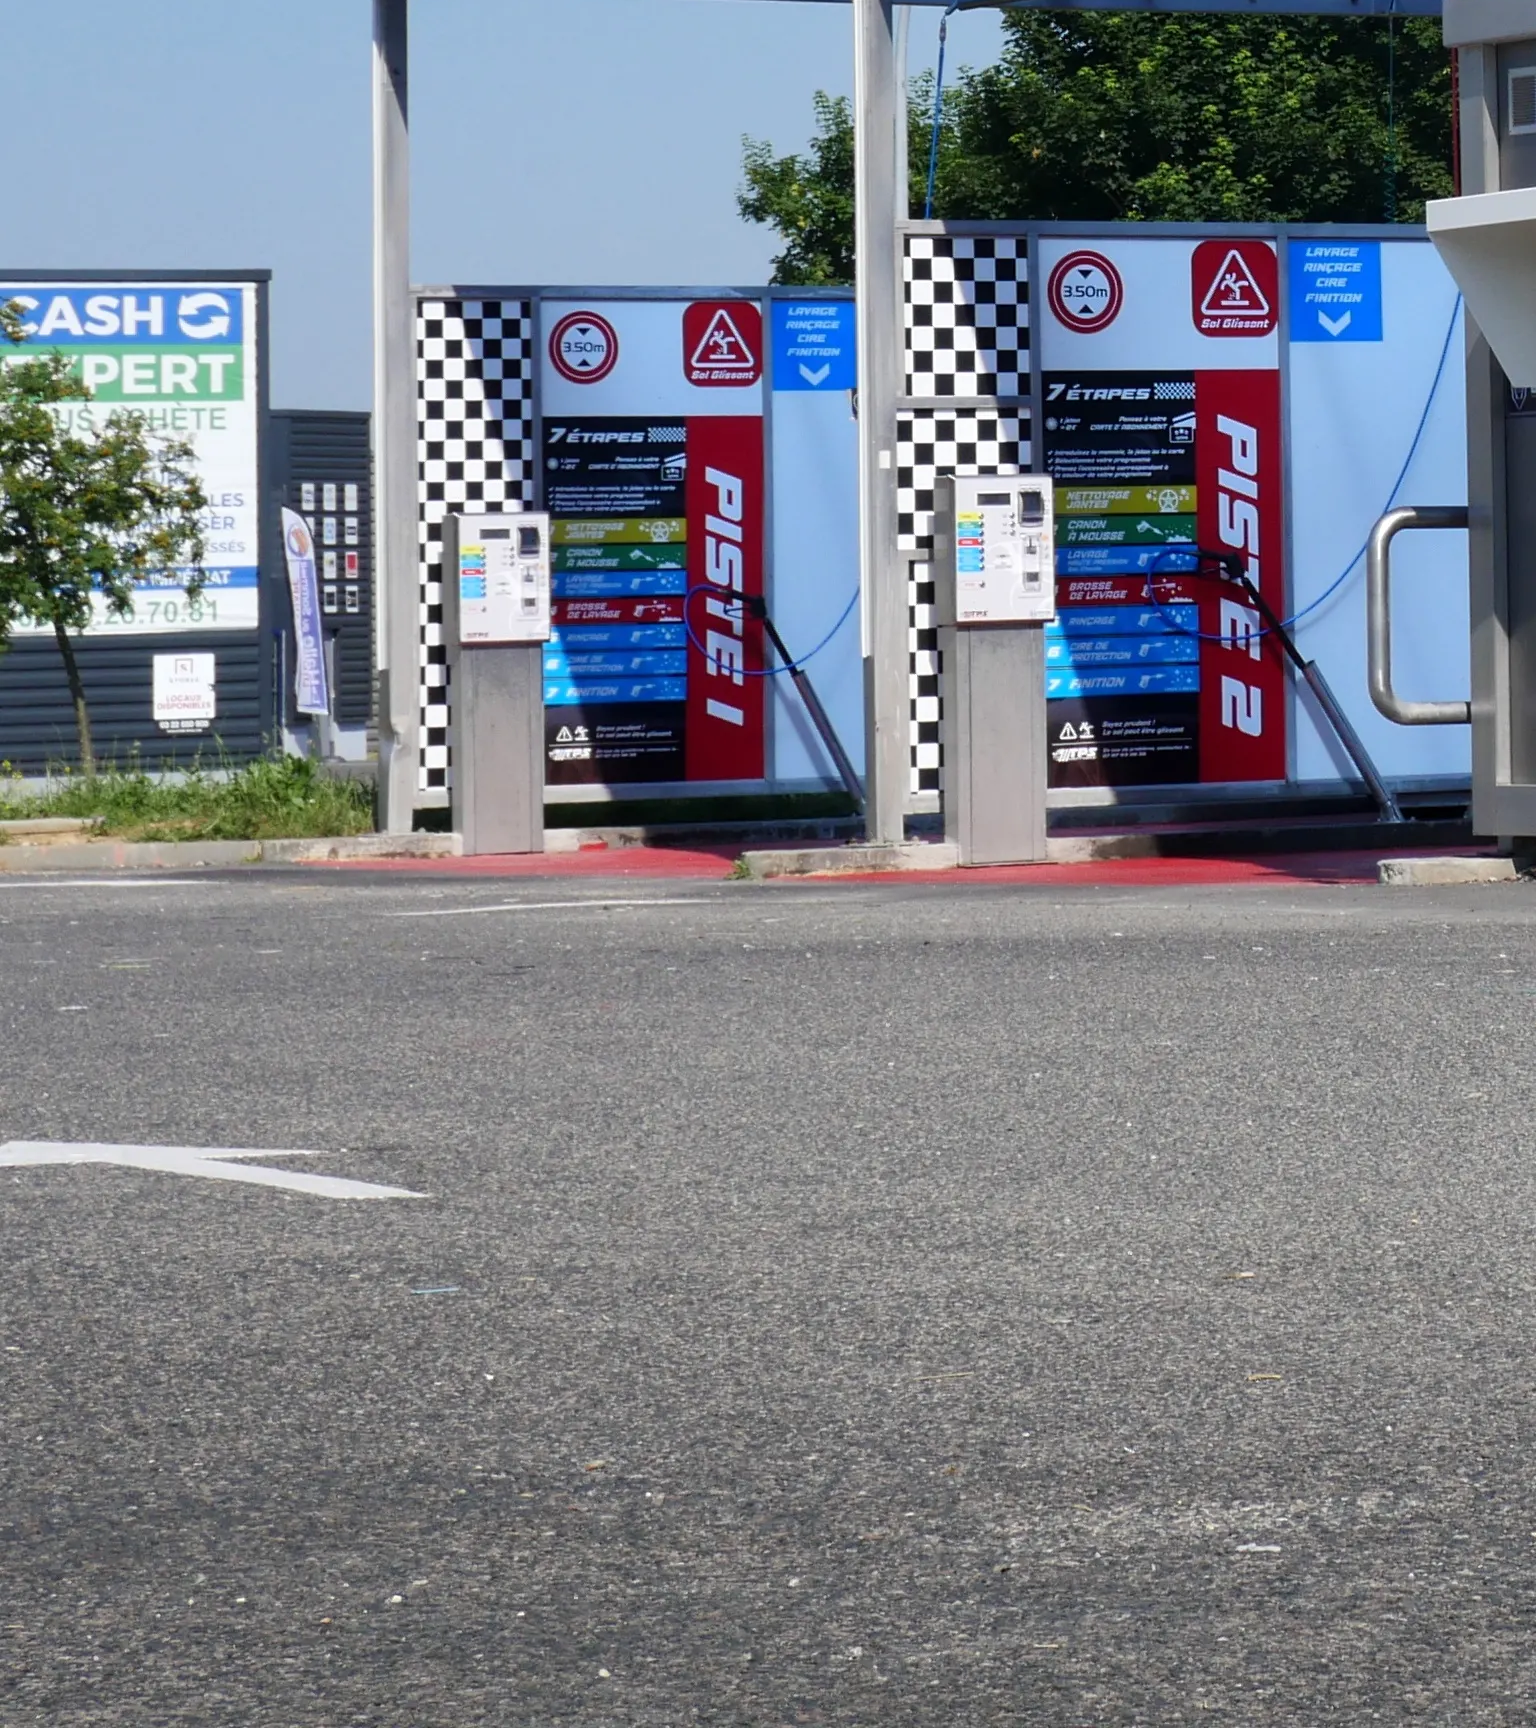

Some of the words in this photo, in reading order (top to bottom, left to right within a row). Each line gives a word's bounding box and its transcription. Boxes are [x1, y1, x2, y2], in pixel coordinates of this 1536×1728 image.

[1305, 247, 1359, 257] LAVAGE
[1303, 262, 1362, 275] RINÇAGE
[1315, 278, 1347, 287] CIRE
[1063, 284, 1108, 299] 3.50m
[1305, 293, 1362, 303] FINITION
[3, 295, 164, 336] CASH
[788, 306, 838, 317] LAVAGE
[786, 319, 841, 332] RINÇAGE
[1201, 317, 1220, 329] Sol
[1223, 317, 1270, 330] Glissant
[797, 333, 826, 344] CIRE
[562, 341, 605, 354] 3.50m
[787, 346, 841, 357] FINITION
[691, 369, 710, 380] Sol
[711, 369, 754, 380] Glissant
[1046, 384, 1066, 400] 7
[1066, 383, 1150, 400] ÉTAPES
[548, 428, 566, 443] 7
[566, 428, 645, 443] ÉTAPES
[704, 465, 744, 686] PISTE
[1221, 674, 1262, 737] 2
